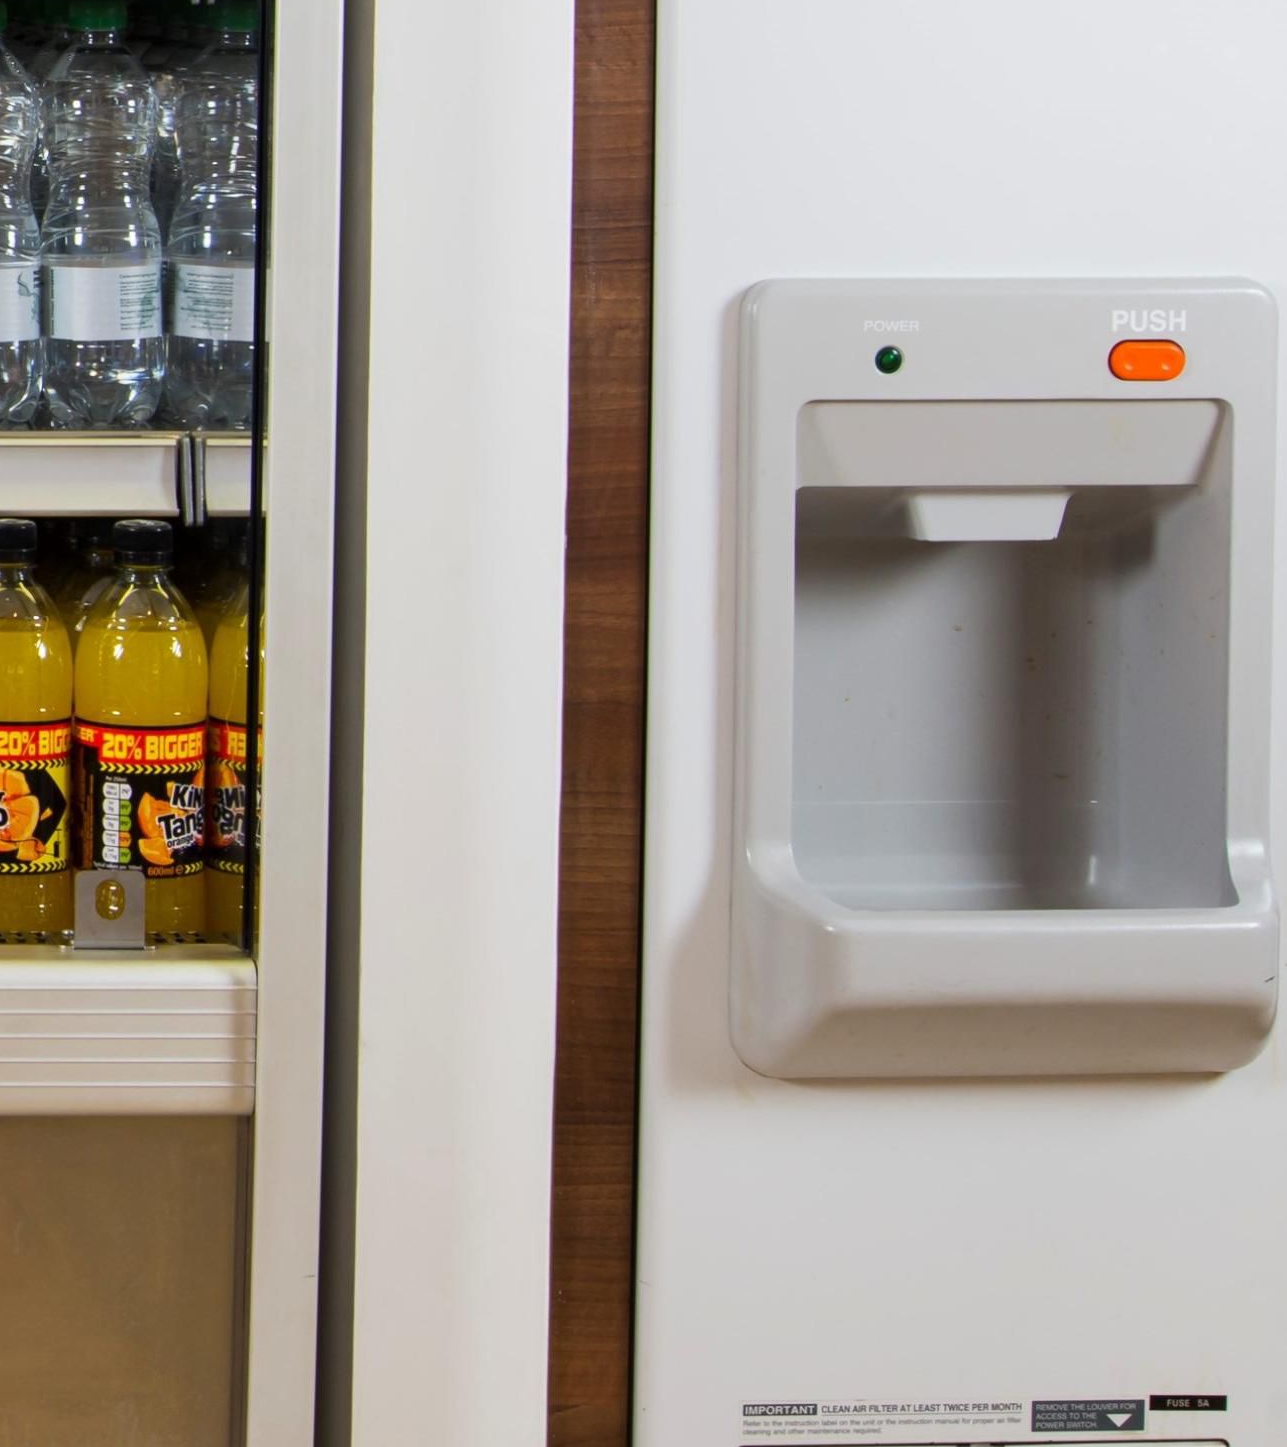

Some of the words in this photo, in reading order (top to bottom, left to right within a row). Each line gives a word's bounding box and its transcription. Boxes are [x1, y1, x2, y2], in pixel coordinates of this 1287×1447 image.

[863, 320, 920, 332] POWER
[1111, 309, 1187, 332] PUSH
[102, 731, 142, 760] 20%
[145, 730, 204, 760] BIGGER
[744, 1405, 815, 1415] IMPORTANT
[821, 1405, 851, 1414] CLEAN
[852, 1405, 867, 1413] AIR
[869, 1404, 898, 1412] FILTER
[899, 1404, 911, 1412] AT
[913, 1404, 940, 1412] LEAST
[991, 1403, 1022, 1411] MONTH
